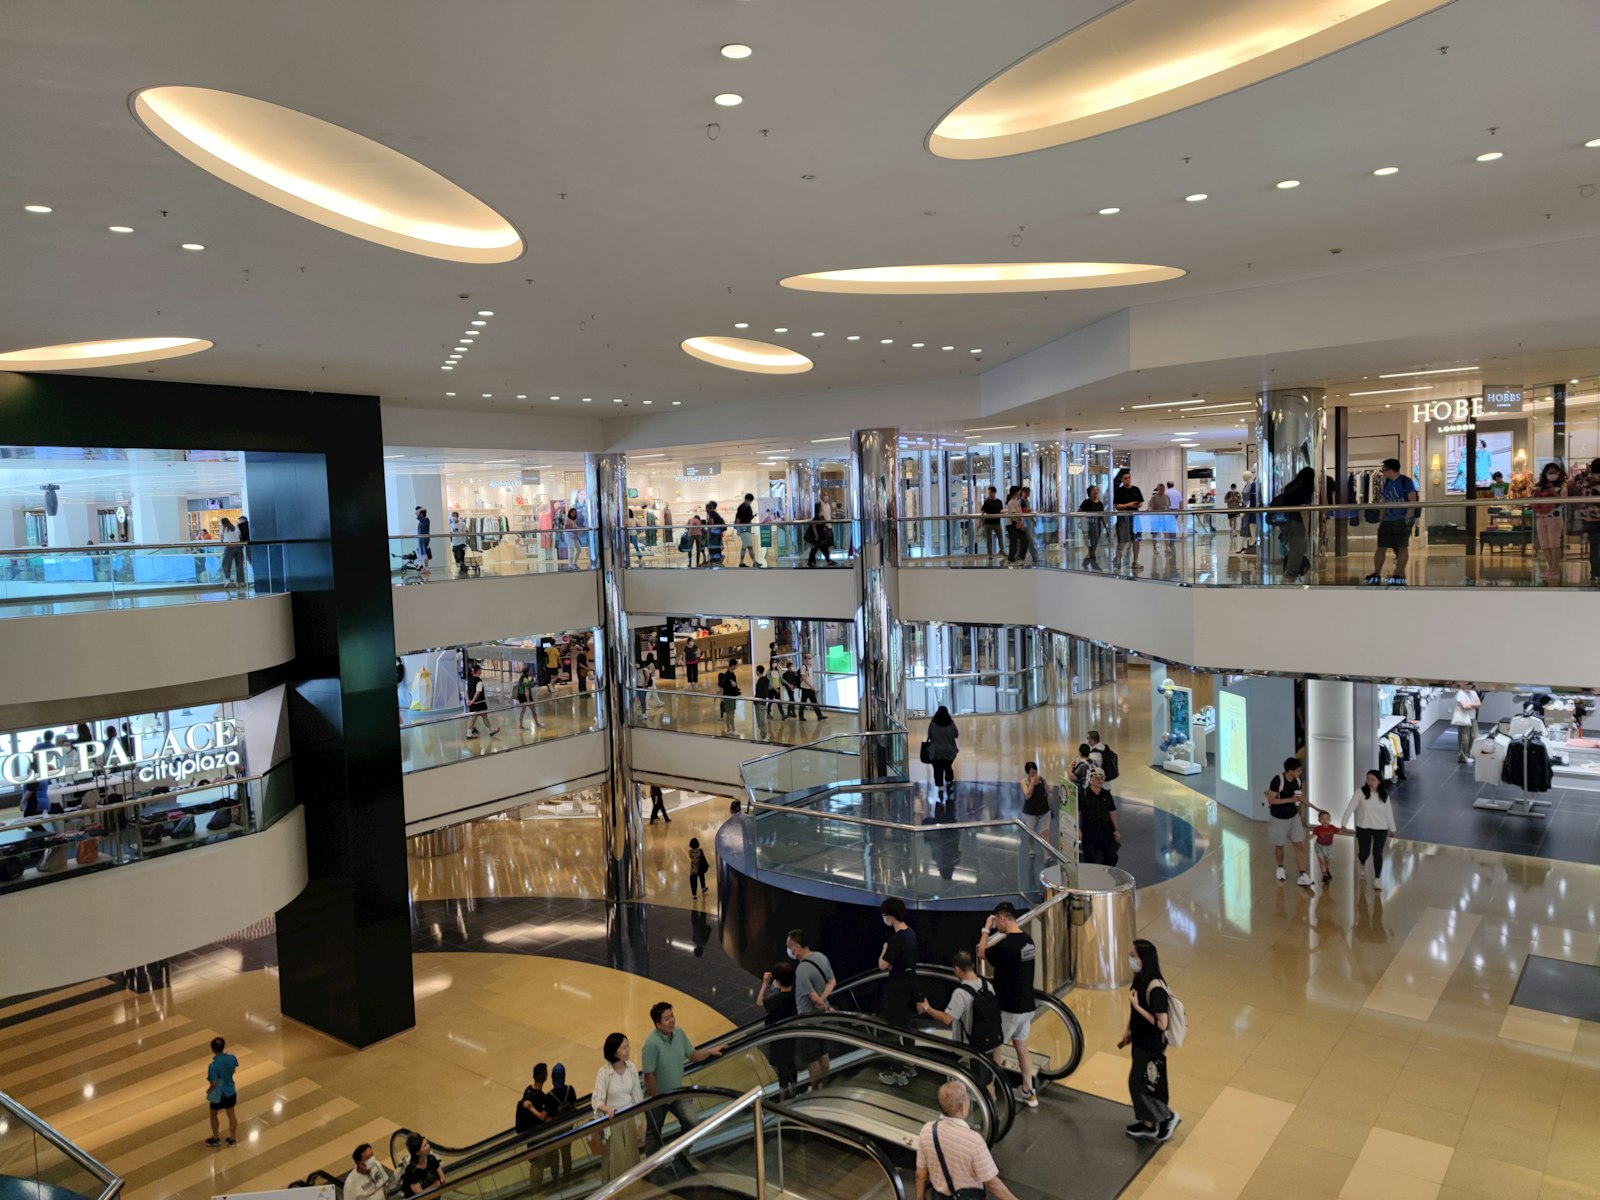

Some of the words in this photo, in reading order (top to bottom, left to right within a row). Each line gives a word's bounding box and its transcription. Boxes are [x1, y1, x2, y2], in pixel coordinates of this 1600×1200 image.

[1487, 393, 1521, 402] HOBBS
[1412, 397, 1498, 423] HOBB
[1437, 424, 1476, 433] LONDON
[931, 438, 937, 449] 2
[73, 718, 239, 774] PALACE
[138, 751, 240, 782] cityplaza
